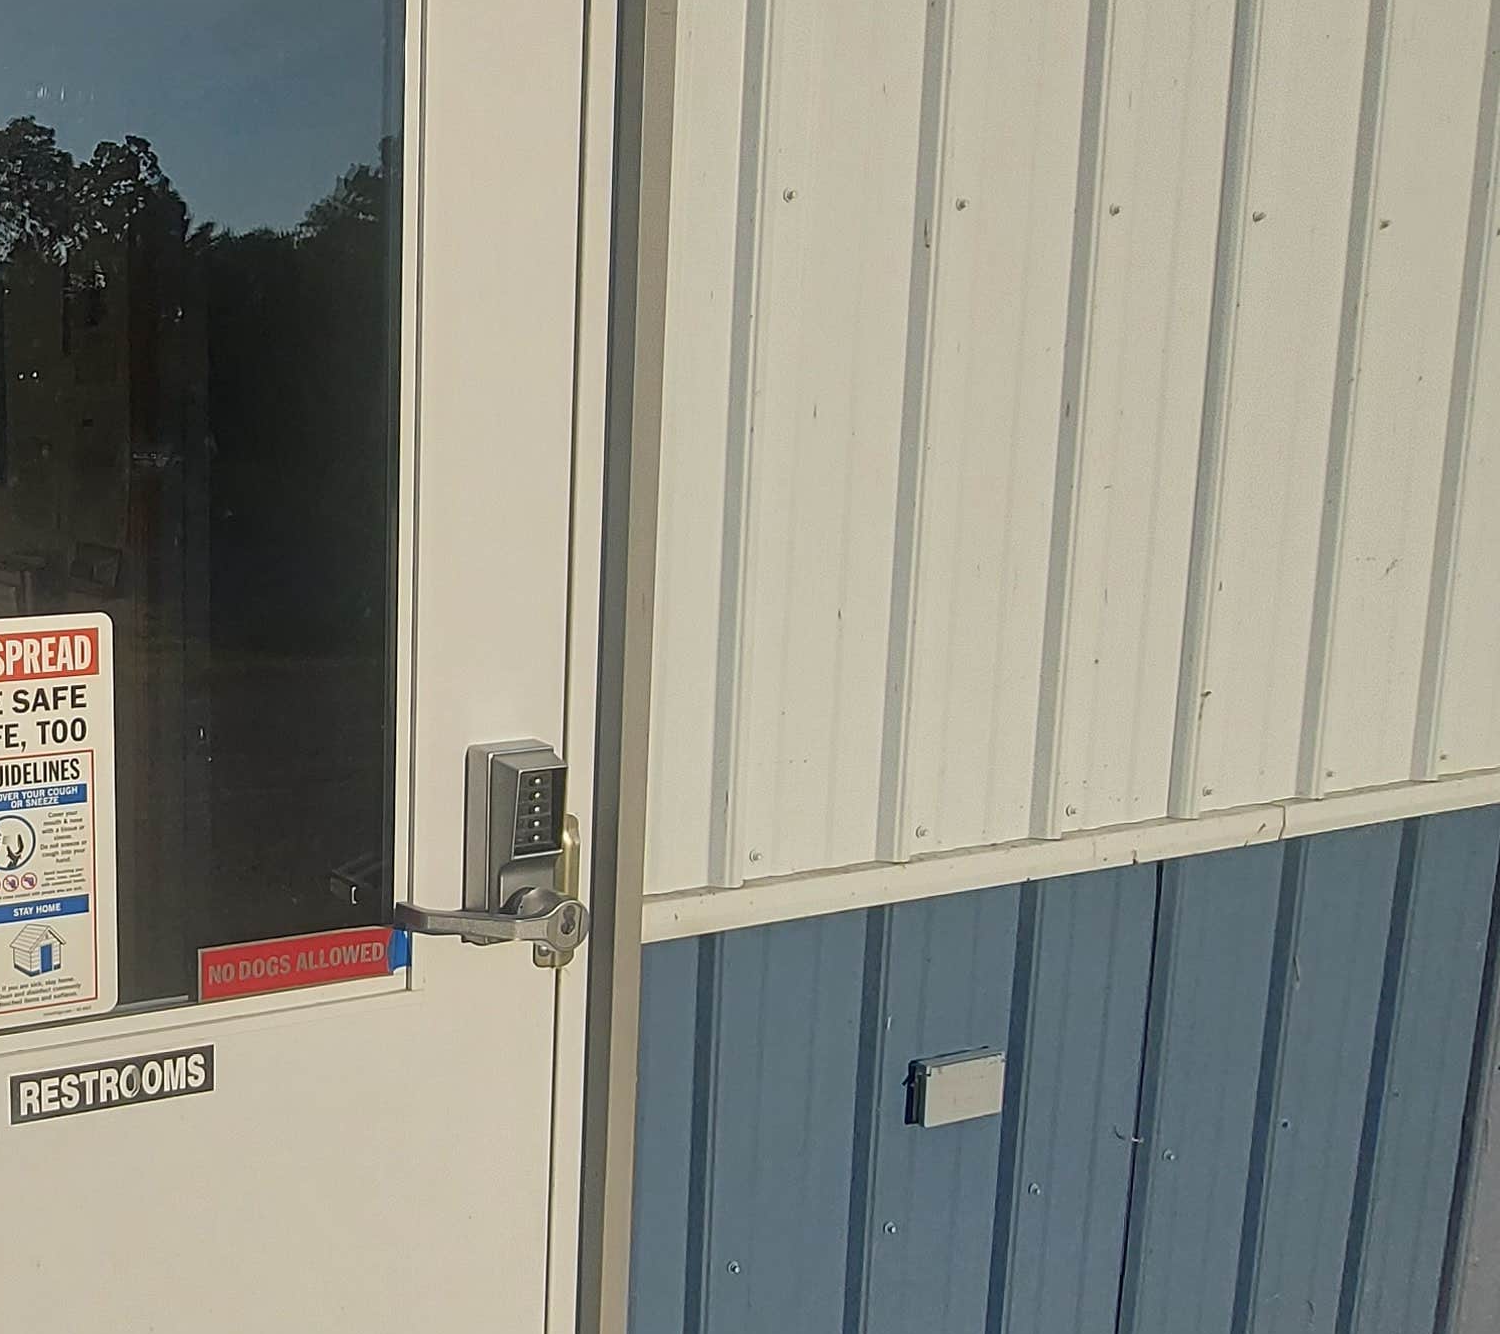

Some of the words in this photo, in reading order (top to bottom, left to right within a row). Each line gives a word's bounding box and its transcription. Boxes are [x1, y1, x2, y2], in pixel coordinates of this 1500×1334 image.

[12, 684, 87, 714] SAFE
[36, 717, 87, 745] TOO
[10, 800, 24, 809] OR
[25, 796, 59, 807] SNEEZE
[21, 789, 46, 799] YOUR
[47, 785, 78, 796] COUGH
[13, 907, 33, 917] STAY
[36, 902, 61, 914] HOME
[208, 963, 235, 985] NO
[239, 954, 291, 980] DOGS
[296, 942, 384, 972] ALLOWED
[19, 1053, 205, 1116] RESTROOMS
